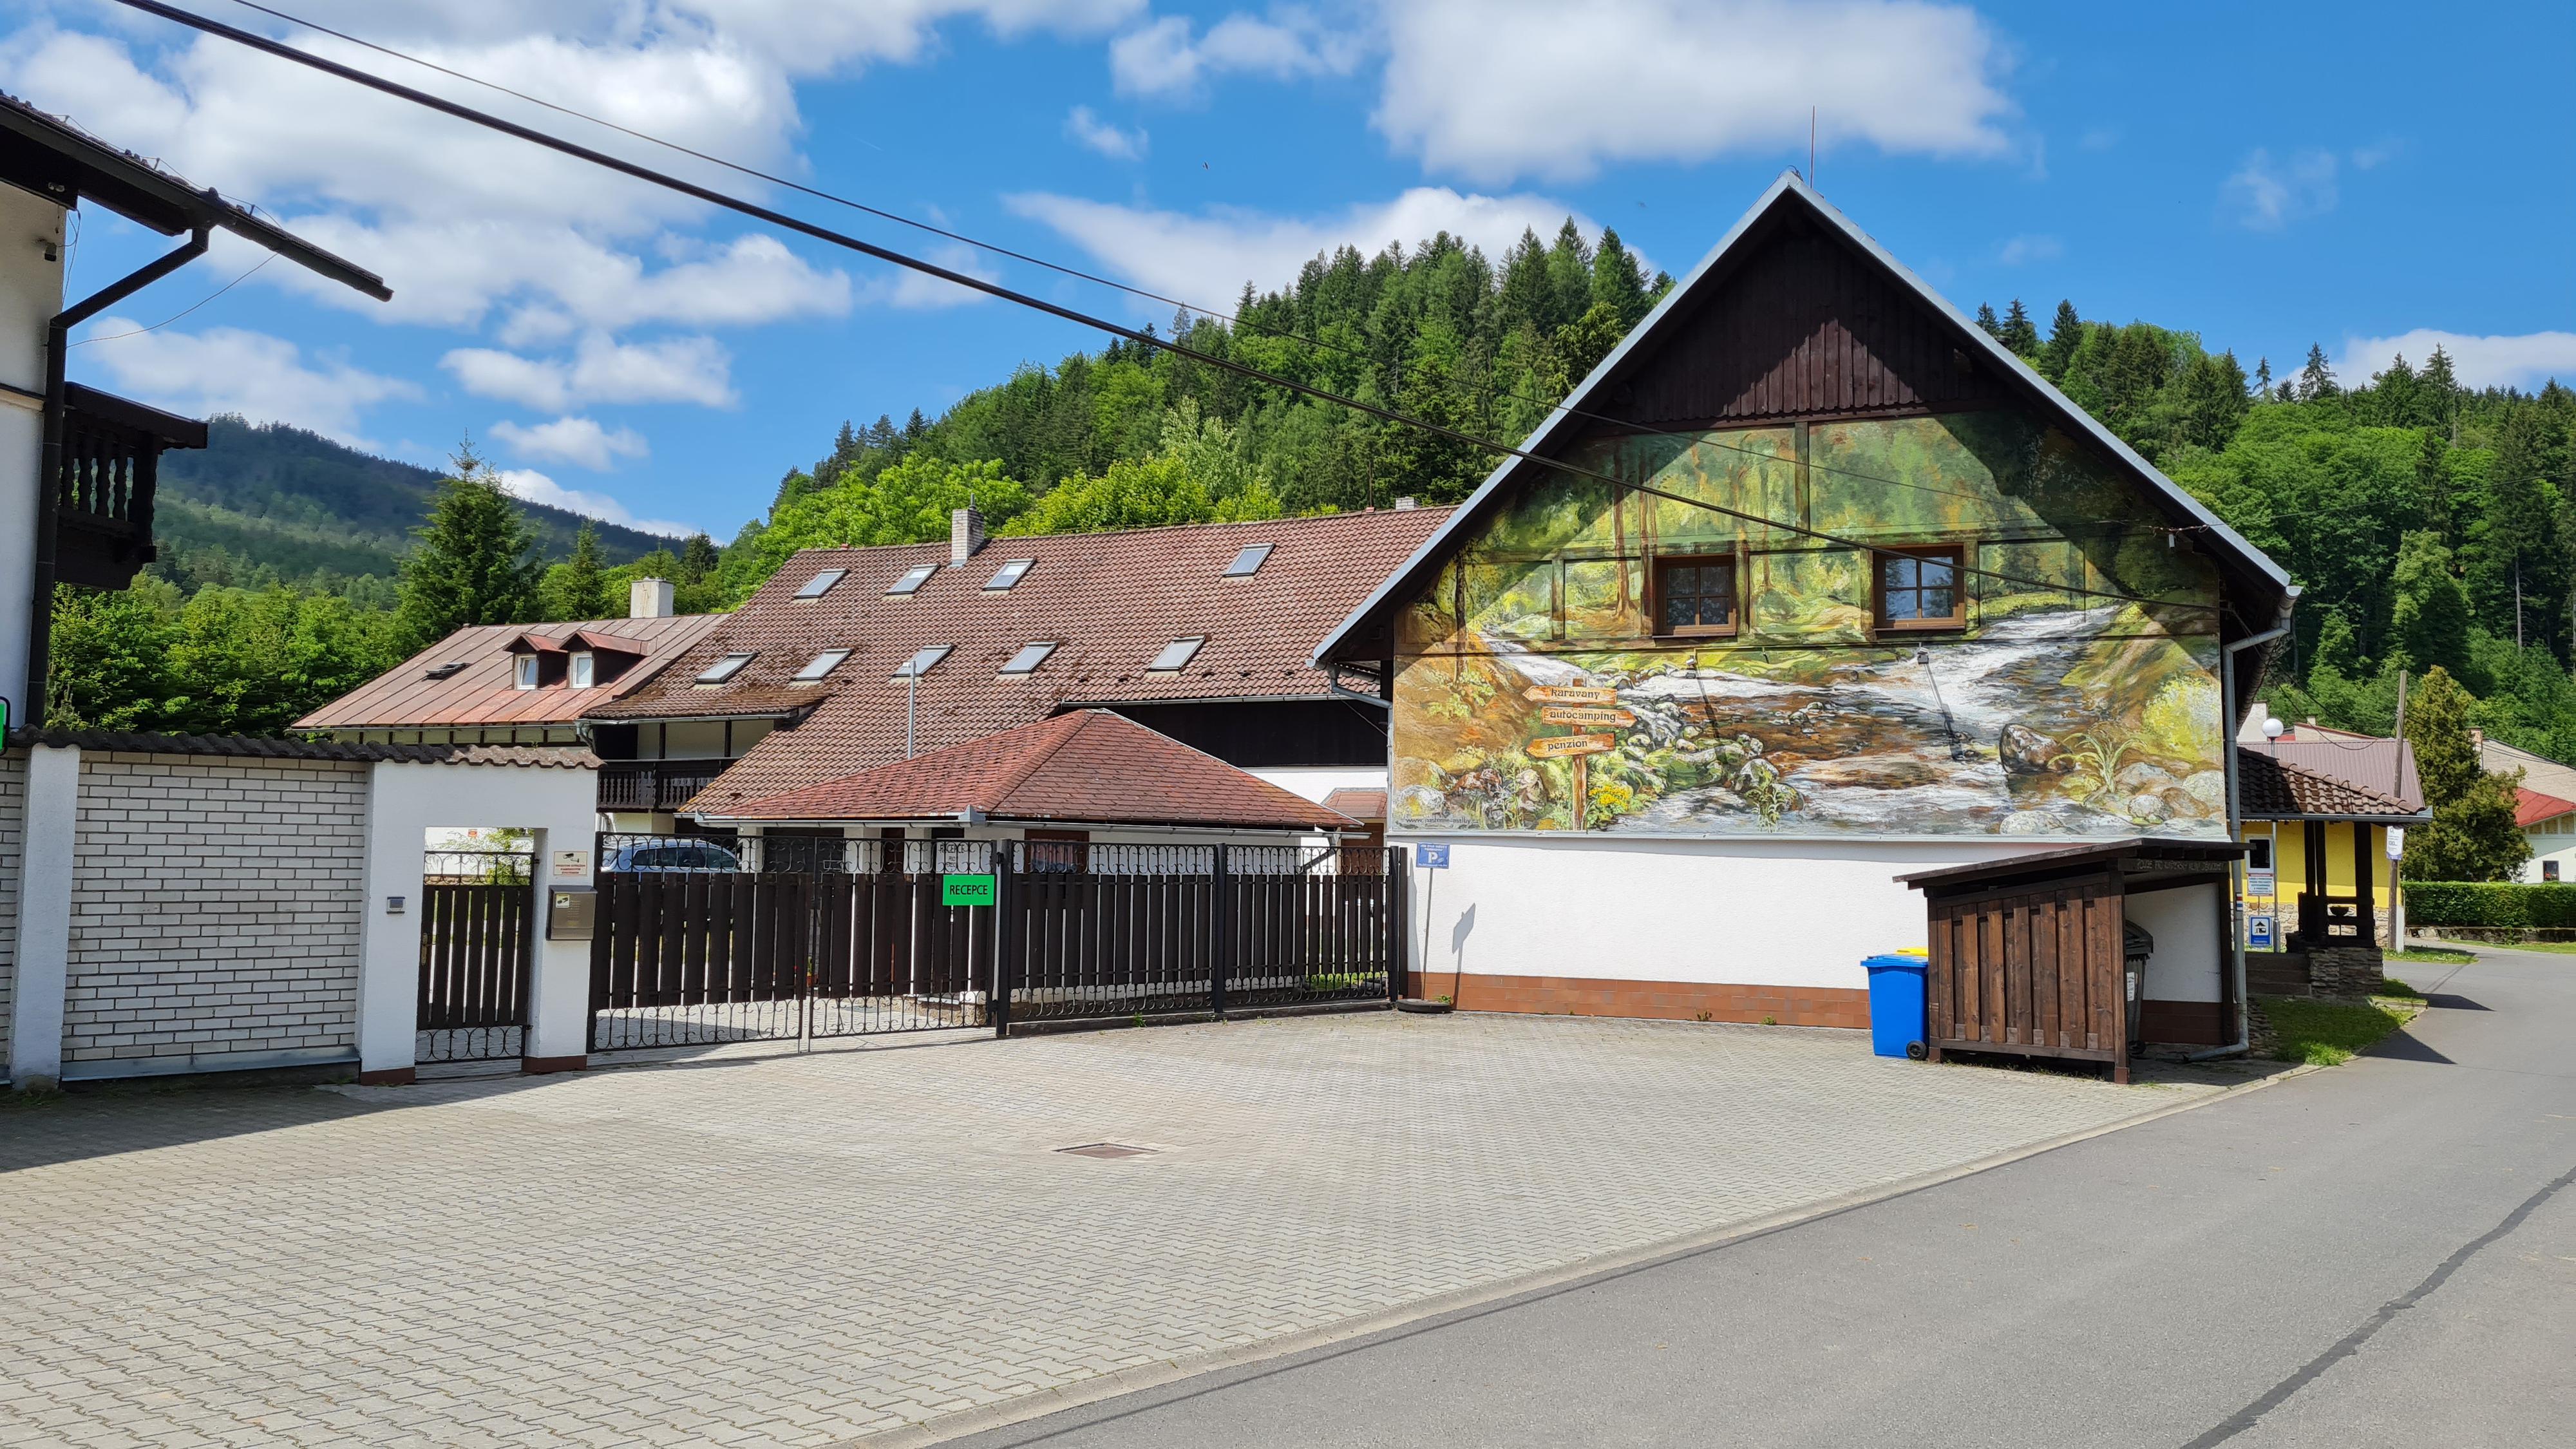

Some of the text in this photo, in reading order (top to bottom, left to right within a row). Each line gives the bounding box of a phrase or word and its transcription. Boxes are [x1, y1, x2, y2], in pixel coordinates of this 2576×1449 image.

[1551, 688, 1600, 699] karavany
[1549, 710, 1616, 723] autocamping
[1548, 739, 1587, 751] penzion
[1428, 851, 1438, 864] P
[949, 885, 989, 895] RECEPCE
